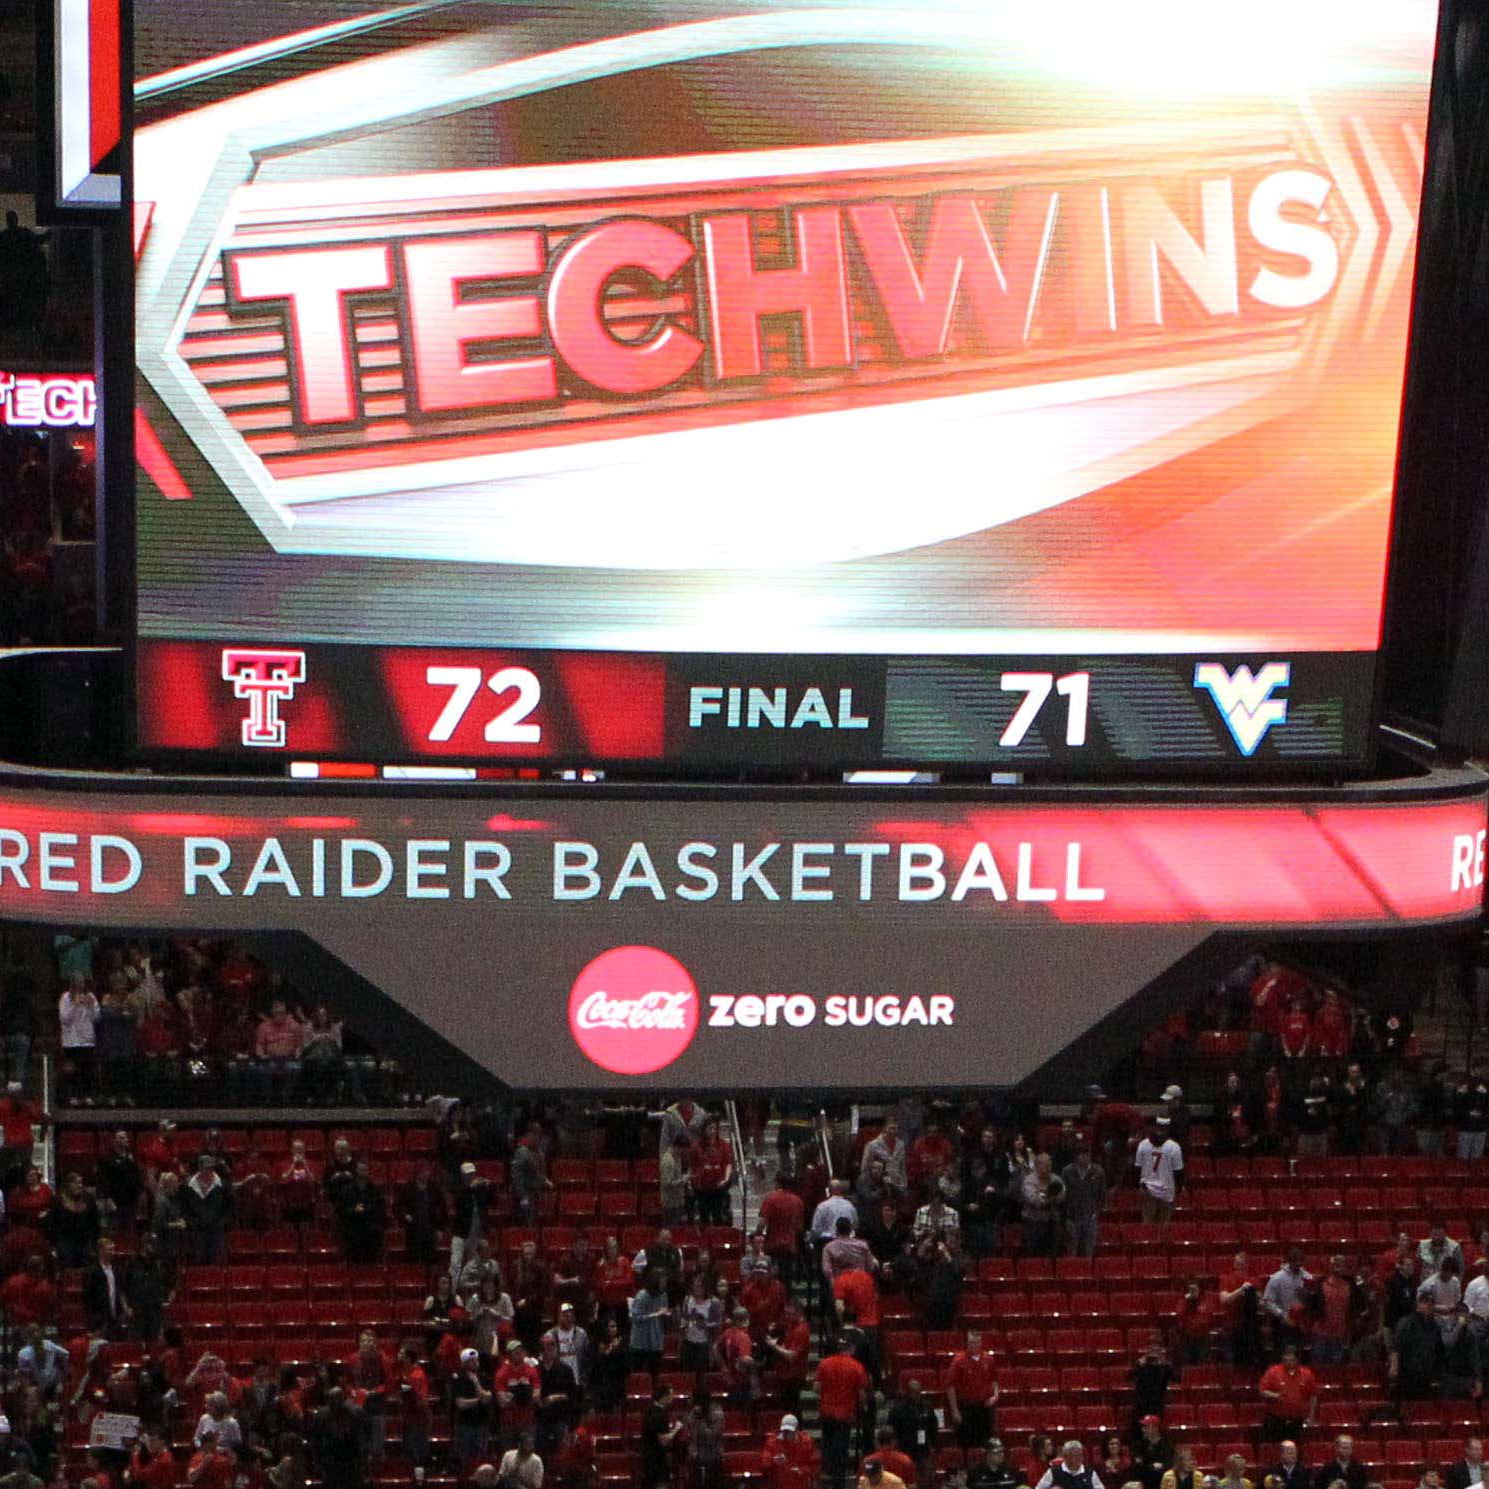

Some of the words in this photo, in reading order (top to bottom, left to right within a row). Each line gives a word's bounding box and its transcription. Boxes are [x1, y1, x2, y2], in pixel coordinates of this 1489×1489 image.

[425, 665, 543, 743] 72
[687, 685, 870, 731] FINAL
[997, 671, 1091, 748] 71
[183, 837, 512, 898] RAIDER
[552, 842, 1105, 900] BASKETBALL
[708, 993, 816, 1027] zero
[824, 994, 955, 1027] SUGAR
